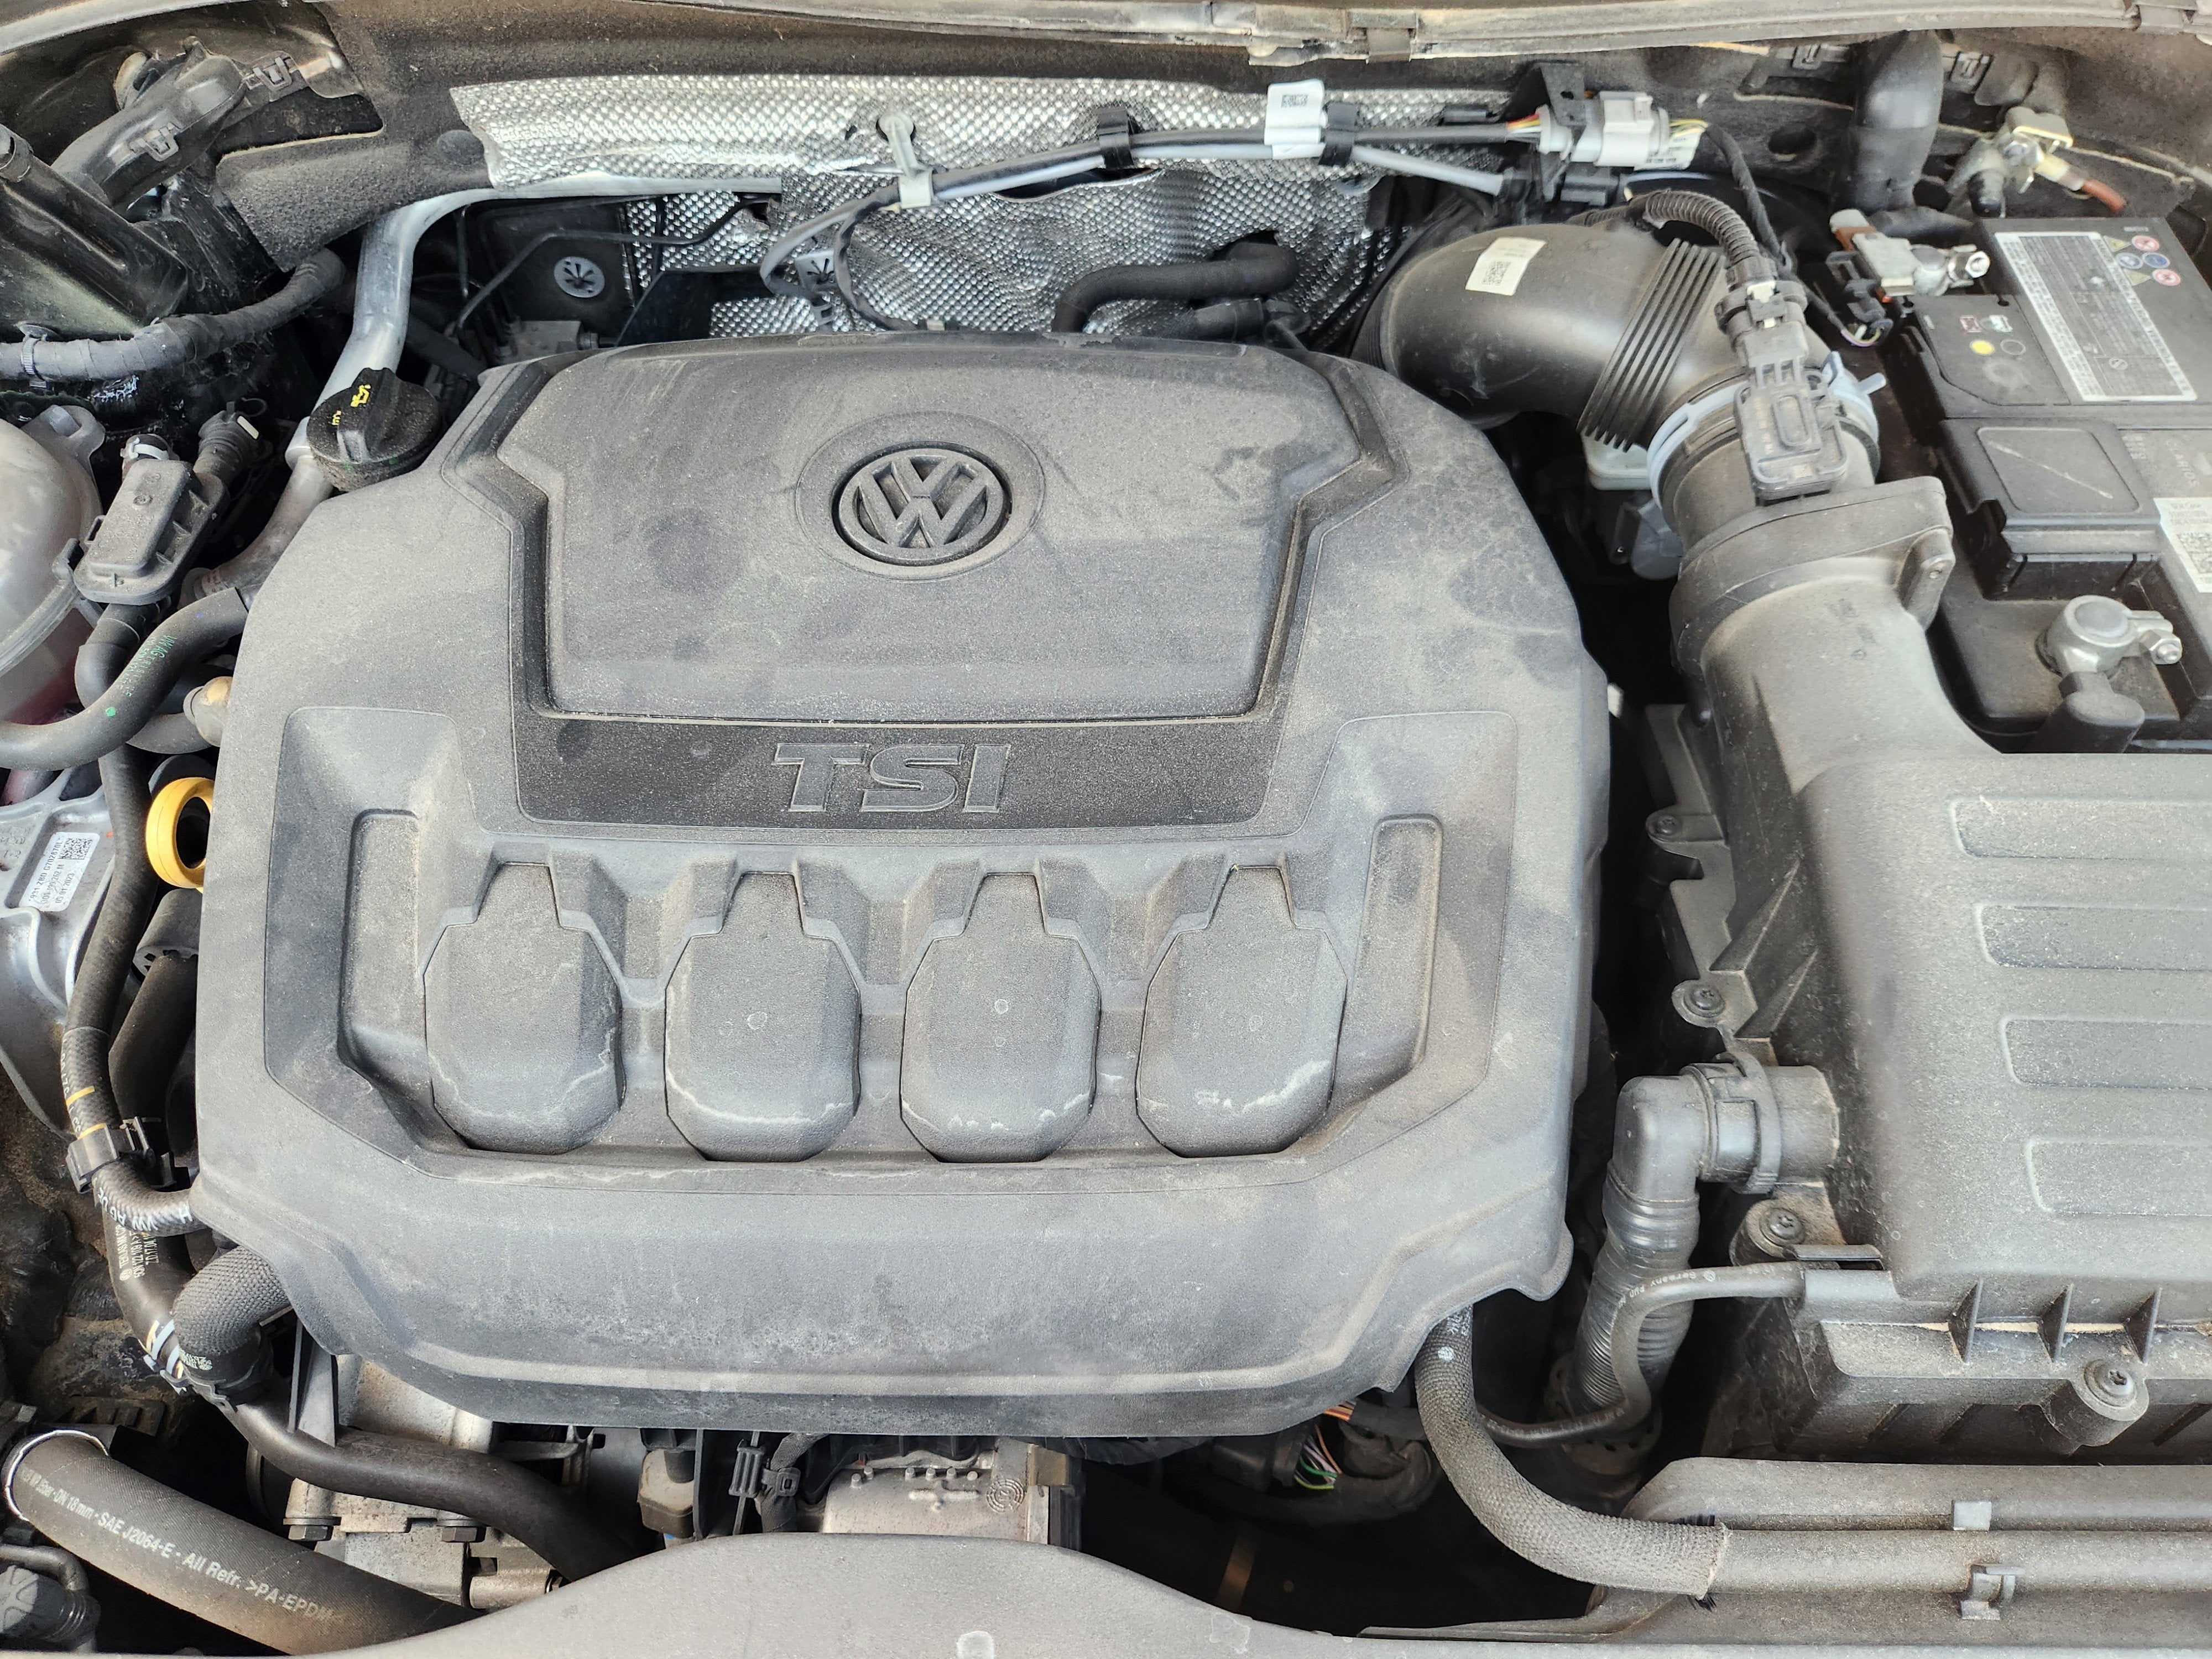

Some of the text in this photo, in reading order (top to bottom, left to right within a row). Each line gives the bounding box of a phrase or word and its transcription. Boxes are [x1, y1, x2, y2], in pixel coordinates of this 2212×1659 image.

[837, 446, 1007, 563] VW
[771, 740, 1011, 813] TSI
[132, 1215, 158, 1232] VW
[1650, 1271, 1697, 1287] Germany
[98, 1511, 125, 1535] SAE
[122, 1525, 176, 1559] J2064-E
[181, 1552, 208, 1572] All
